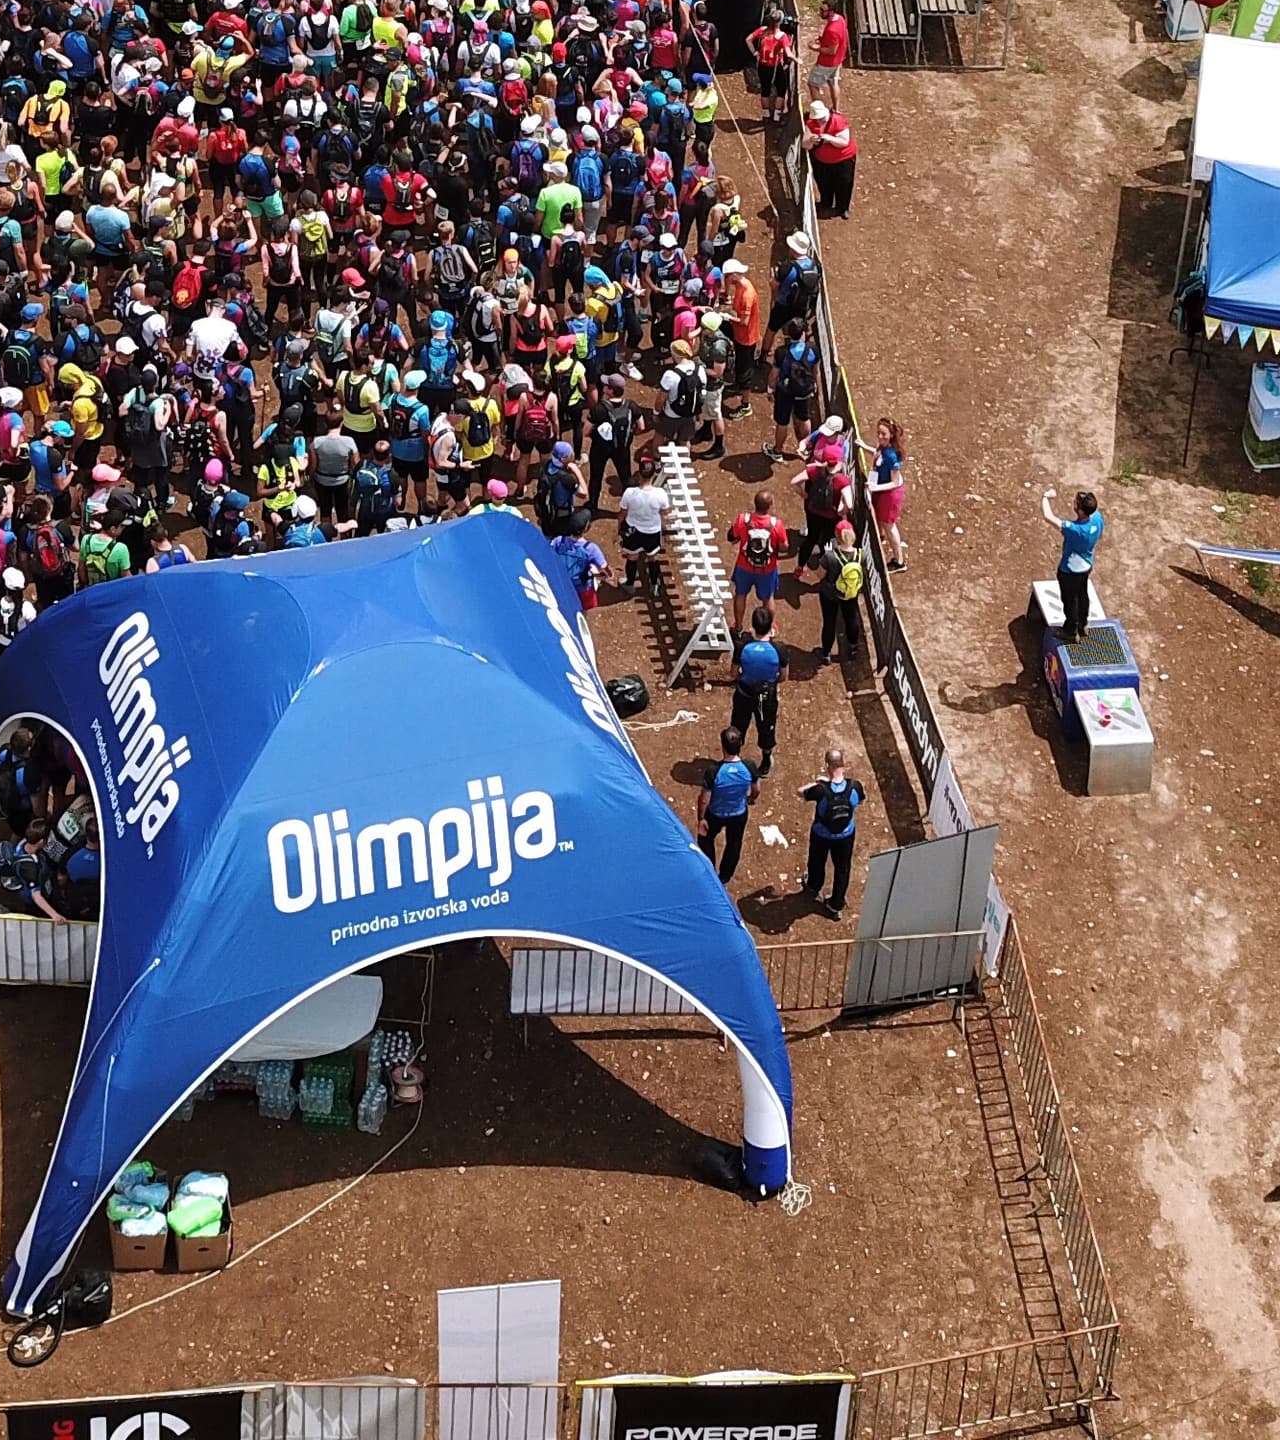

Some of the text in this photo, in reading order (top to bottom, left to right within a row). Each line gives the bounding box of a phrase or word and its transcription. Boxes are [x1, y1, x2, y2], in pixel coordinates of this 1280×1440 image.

[99, 611, 191, 843] Olimpija
[893, 649, 938, 782] Supradyn
[266, 775, 558, 914] Olimpija
[330, 888, 511, 946] prirodna izvorska voda
[625, 1423, 819, 1440] POWERADE
